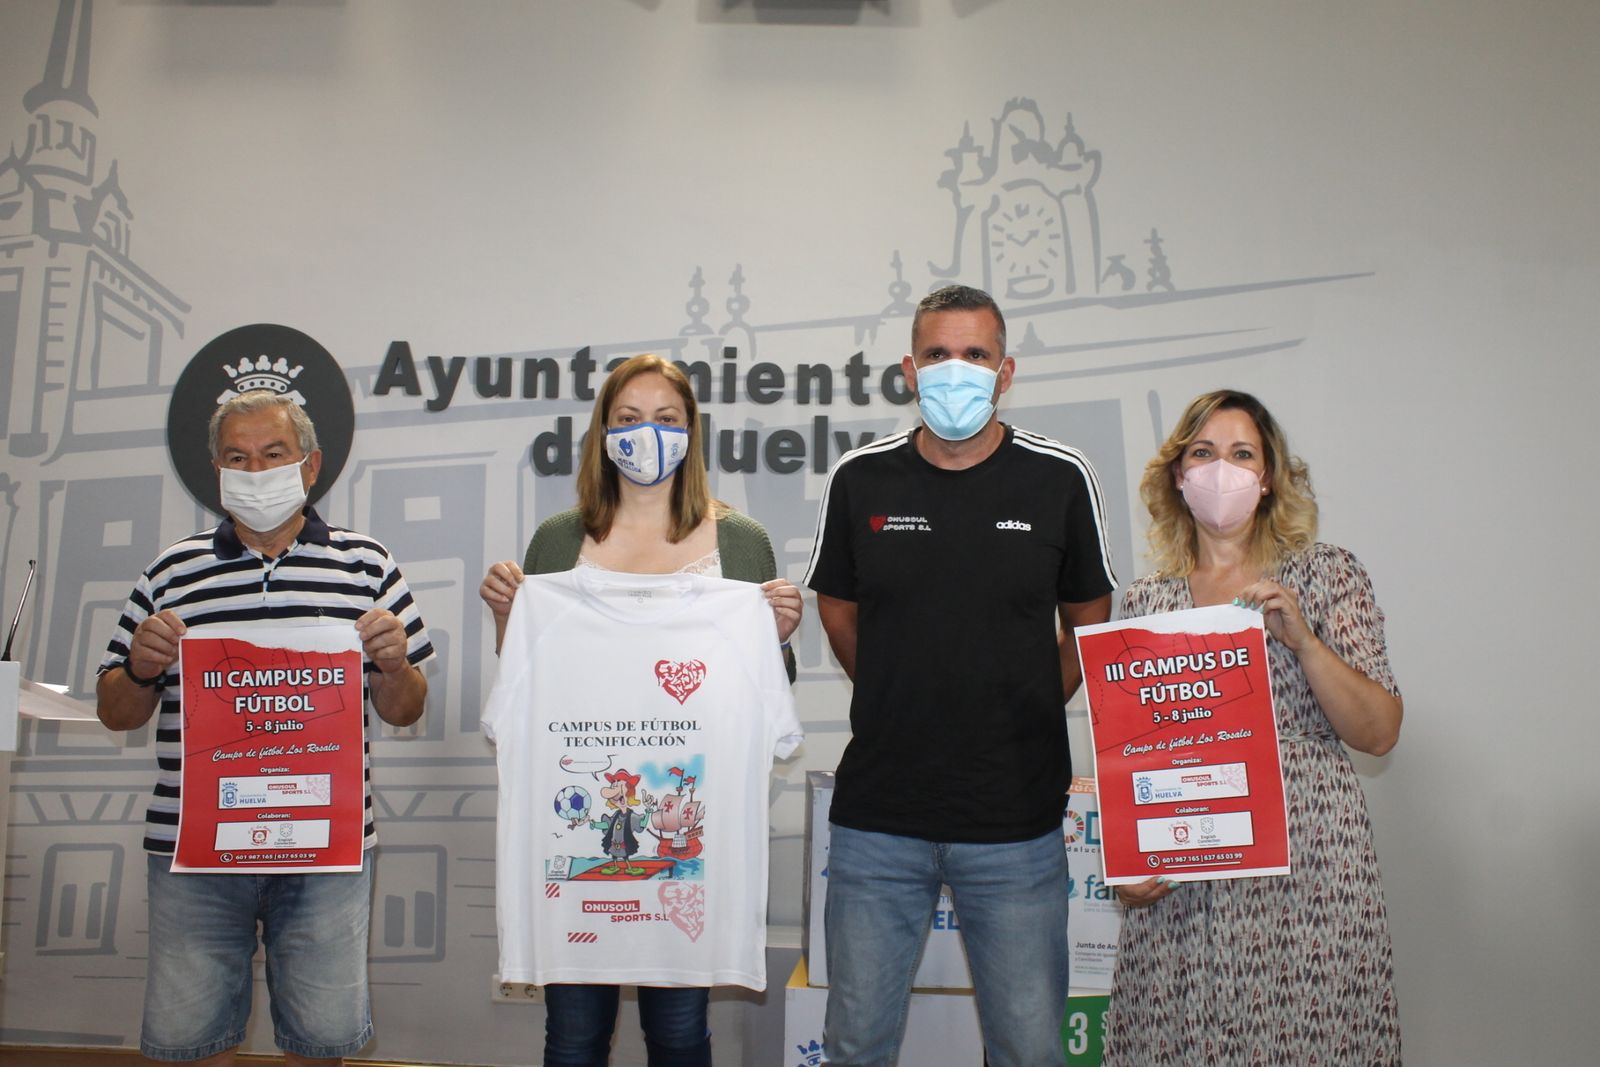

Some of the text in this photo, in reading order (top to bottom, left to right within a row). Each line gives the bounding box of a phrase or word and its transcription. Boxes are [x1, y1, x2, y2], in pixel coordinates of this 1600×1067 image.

[699, 413, 902, 474] uelv
[995, 520, 1031, 531] adidas
[1104, 648, 1249, 682] III CAMPUS DE
[203, 668, 345, 688] III CAMPUS DE
[1139, 680, 1221, 705] FÚTBOL
[235, 693, 315, 713] FÚTBOL
[1153, 711, 1160, 723] 5
[1171, 709, 1180, 721] 8
[1182, 707, 1212, 723] julio
[246, 721, 254, 732] 5
[264, 720, 273, 731] 8
[273, 720, 304, 733] julio
[548, 718, 701, 733] CAMPUS DE FÚTBOL
[564, 734, 686, 747] TECNIFICACIÓN
[1123, 729, 1252, 757] Campo de fútbol Los Rosales
[212, 742, 341, 762] Campo de fútbol Los Rosales
[1155, 791, 1182, 799] HUELVA
[584, 903, 638, 911] ONUSOUL
[610, 914, 651, 922] SPORTS
[1069, 1011, 1088, 1055] 3
